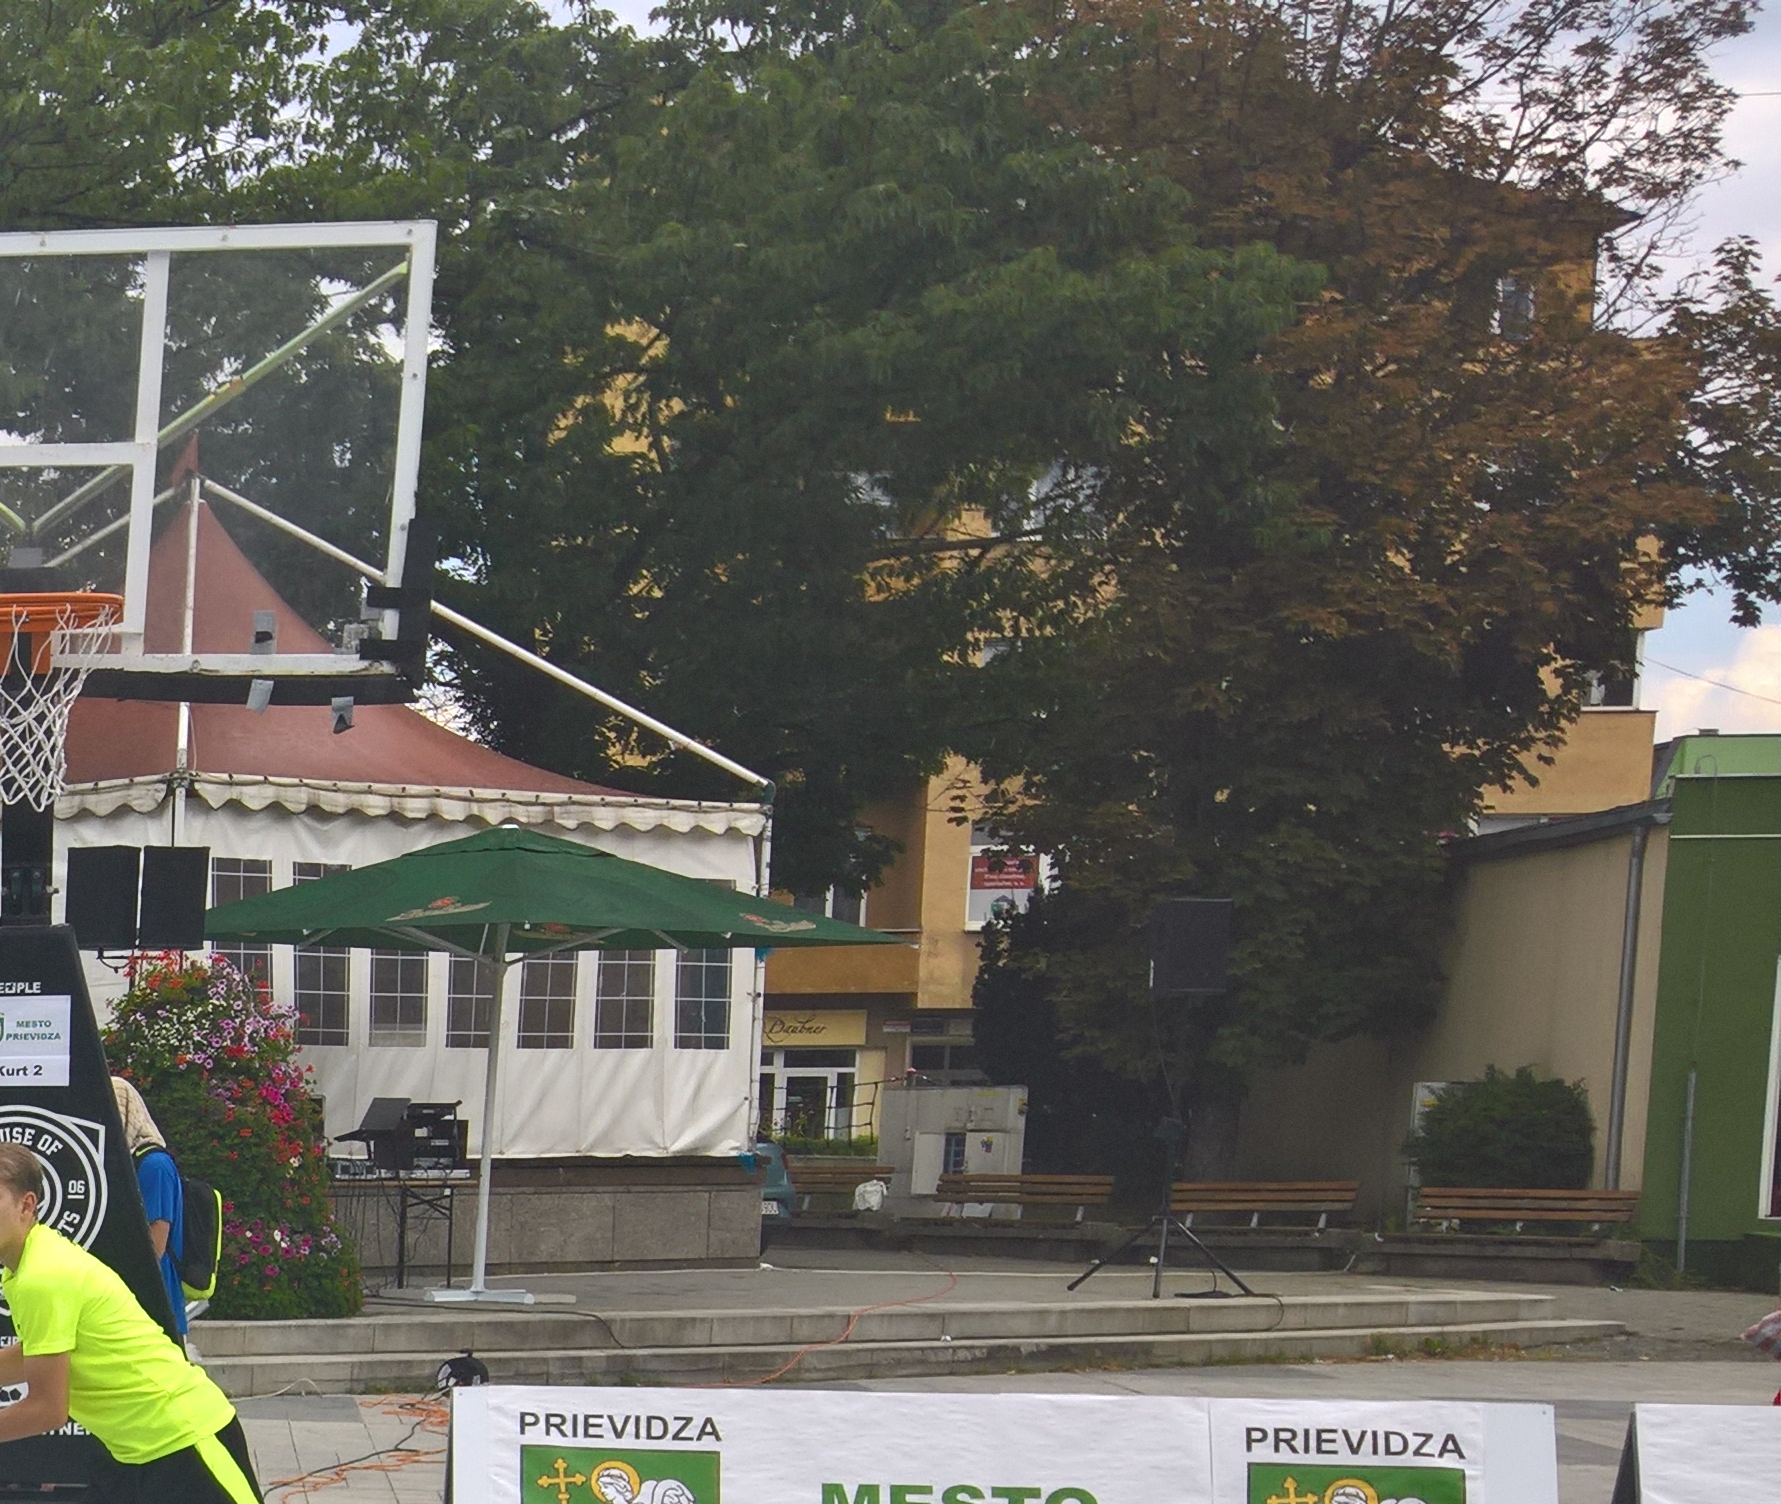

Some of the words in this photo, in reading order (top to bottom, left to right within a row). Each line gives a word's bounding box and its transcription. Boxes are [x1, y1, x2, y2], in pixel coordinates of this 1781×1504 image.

[16, 1020, 52, 1028] MESTO
[6, 1033, 61, 1041] PRIEVIDZA
[33, 1065, 43, 1076] 2
[37, 1134, 64, 1156] OF
[67, 1180, 85, 1193] 06
[519, 1411, 723, 1443] PRIEVIDZA
[1244, 1425, 1467, 1461] PRIEVIDZA
